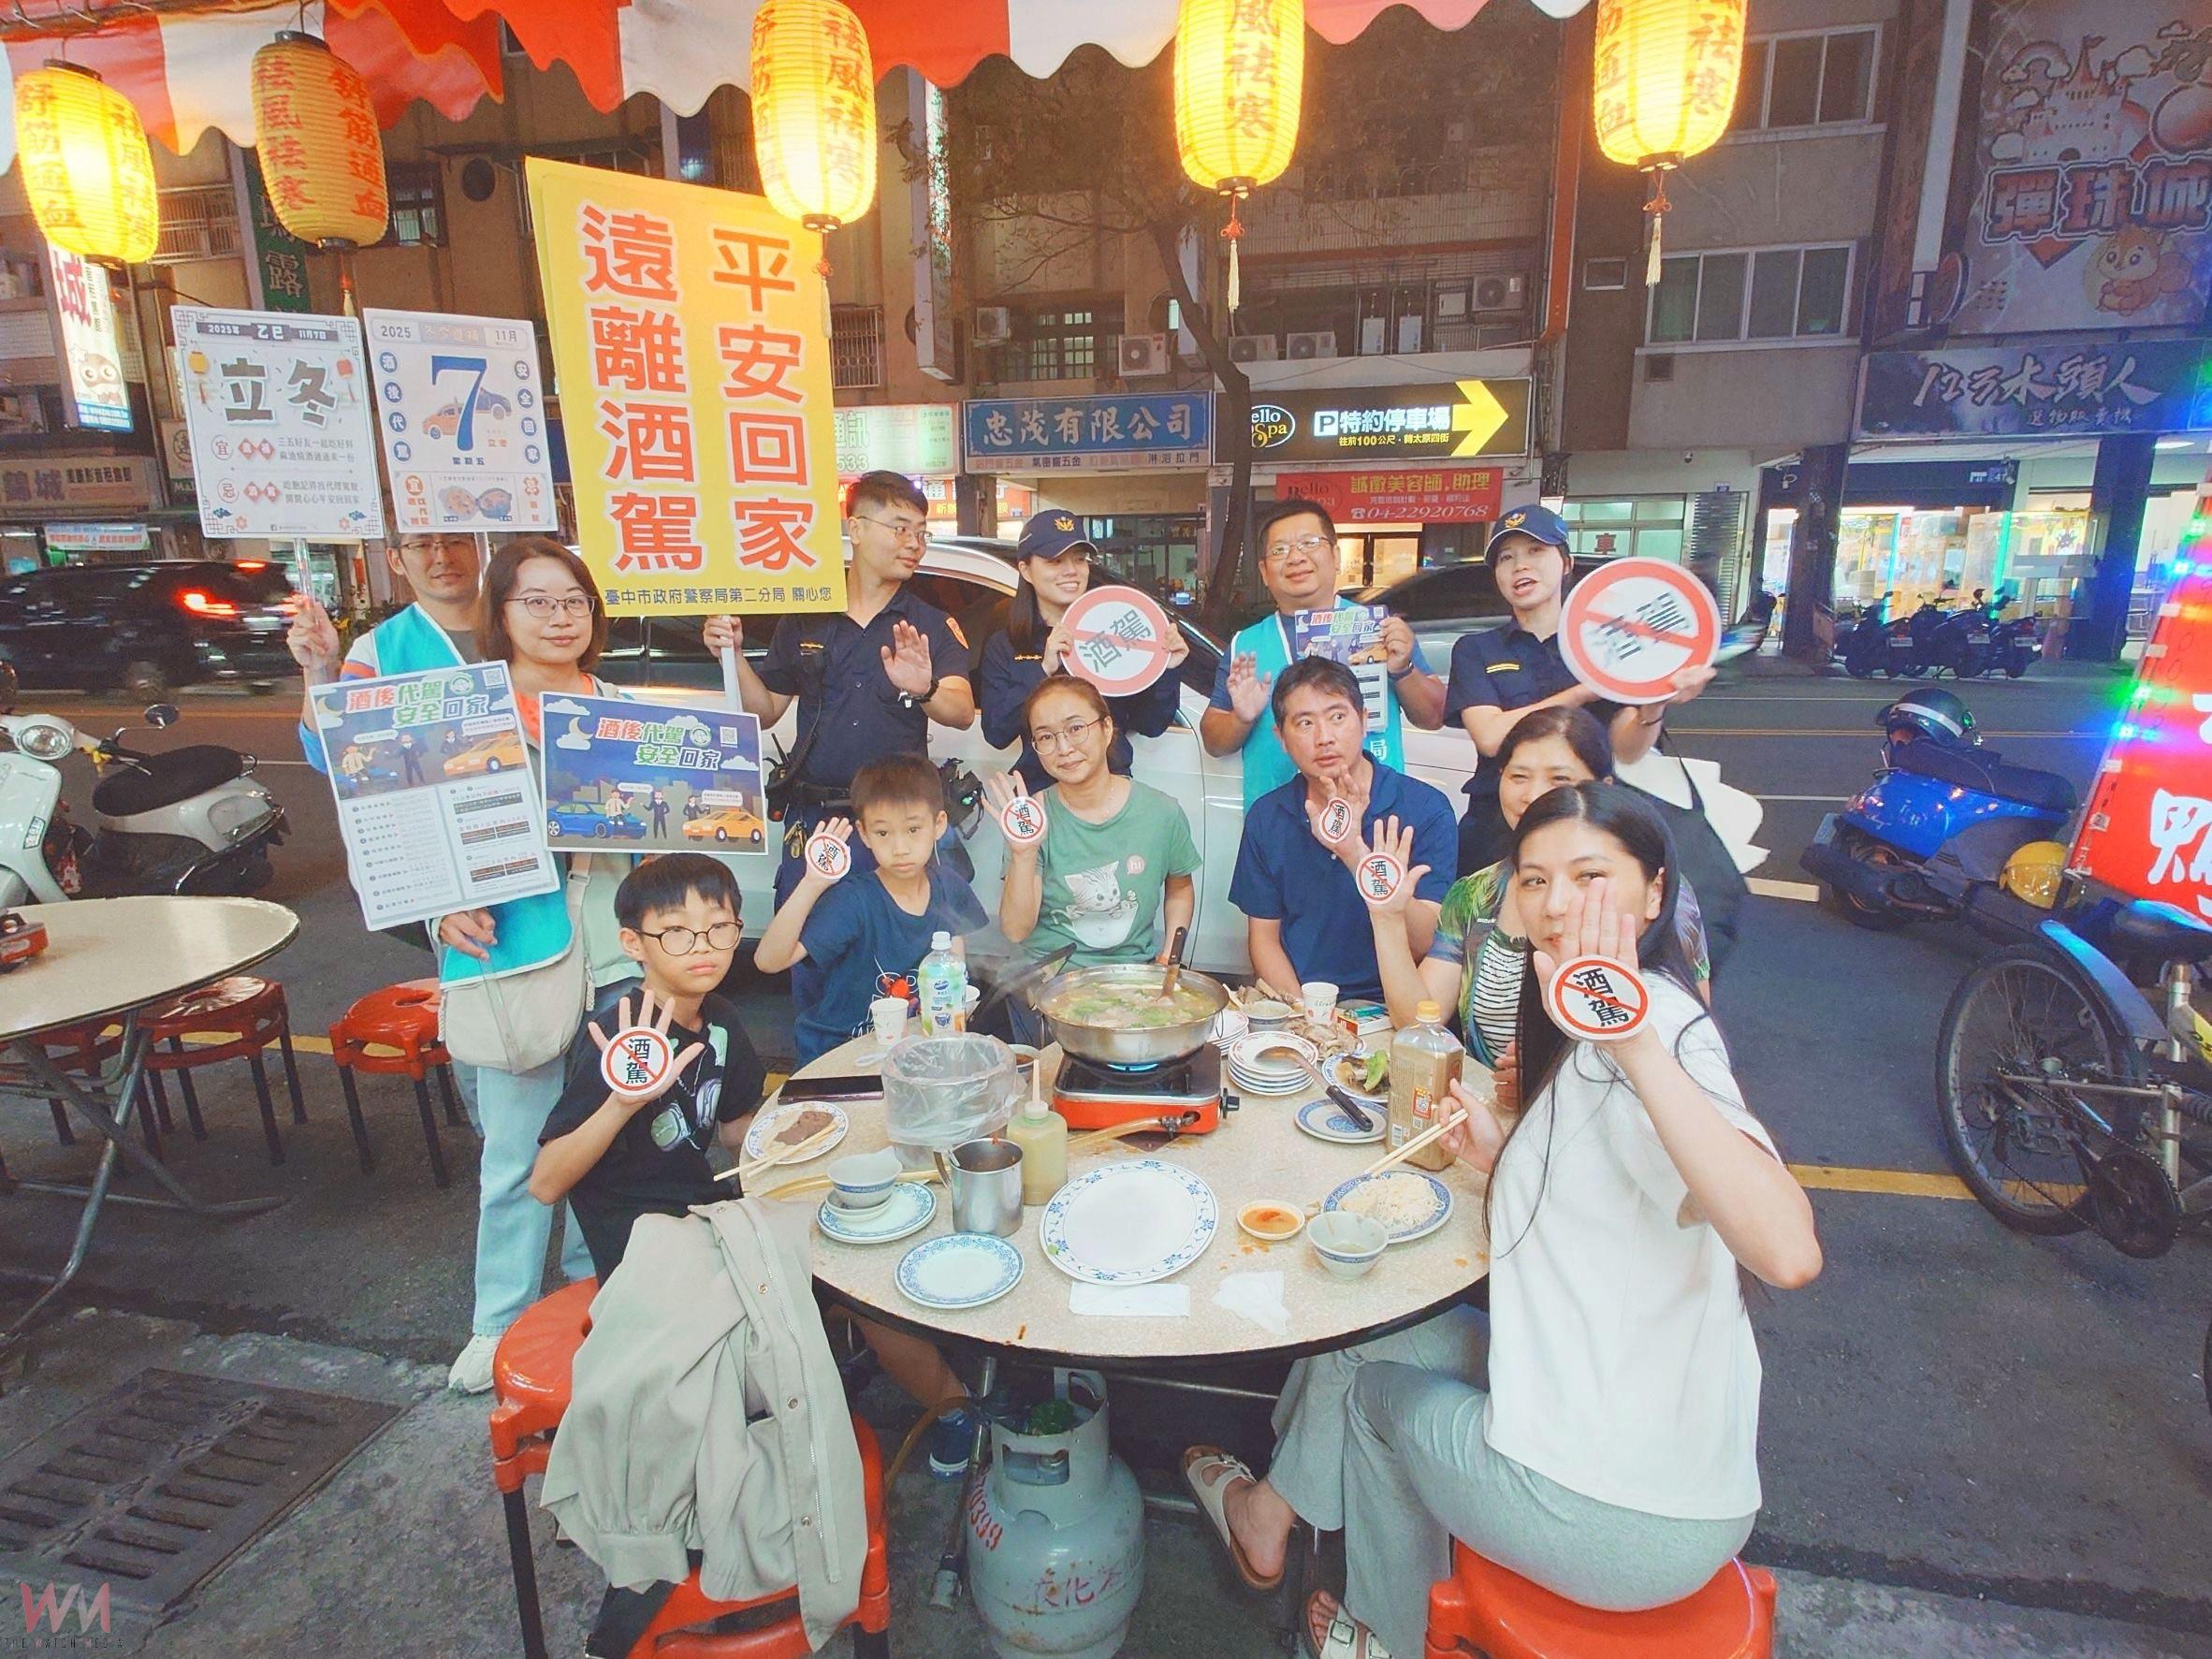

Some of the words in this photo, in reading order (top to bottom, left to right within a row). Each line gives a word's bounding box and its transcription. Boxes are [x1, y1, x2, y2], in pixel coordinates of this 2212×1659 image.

[257, 324, 284, 340] 乙巳
[298, 329, 327, 340] 11月7日
[381, 326, 412, 338] 2025
[495, 330, 517, 342] 11月
[221, 357, 337, 426] 立冬
[431, 356, 488, 451] 7
[583, 205, 703, 572] 遠離酒駕
[713, 228, 816, 571] 平安回家
[516, 362, 540, 462] 安全回家
[984, 403, 1191, 446] 忠茂有限公司
[1339, 407, 1450, 432] 特約停車場
[216, 440, 228, 455] 宜
[1147, 452, 1200, 464] 淋浴拉門
[223, 483, 236, 499] 忌
[1367, 506, 1489, 519] 04-22920768
[605, 587, 785, 605] 臺中市政府警察局第二分局
[793, 587, 832, 603] 關心您
[1079, 609, 1152, 673] 酒駕
[346, 680, 444, 713] 酒後代駕
[393, 693, 489, 727] 安全回家
[596, 717, 685, 746] 酒後代駕
[634, 745, 721, 770] 安全回家
[1015, 804, 1034, 835] 酒駕
[1371, 860, 1389, 896] 酒駕
[1573, 968, 1629, 1026] 酒駕
[626, 1038, 651, 1084] 酒駕
